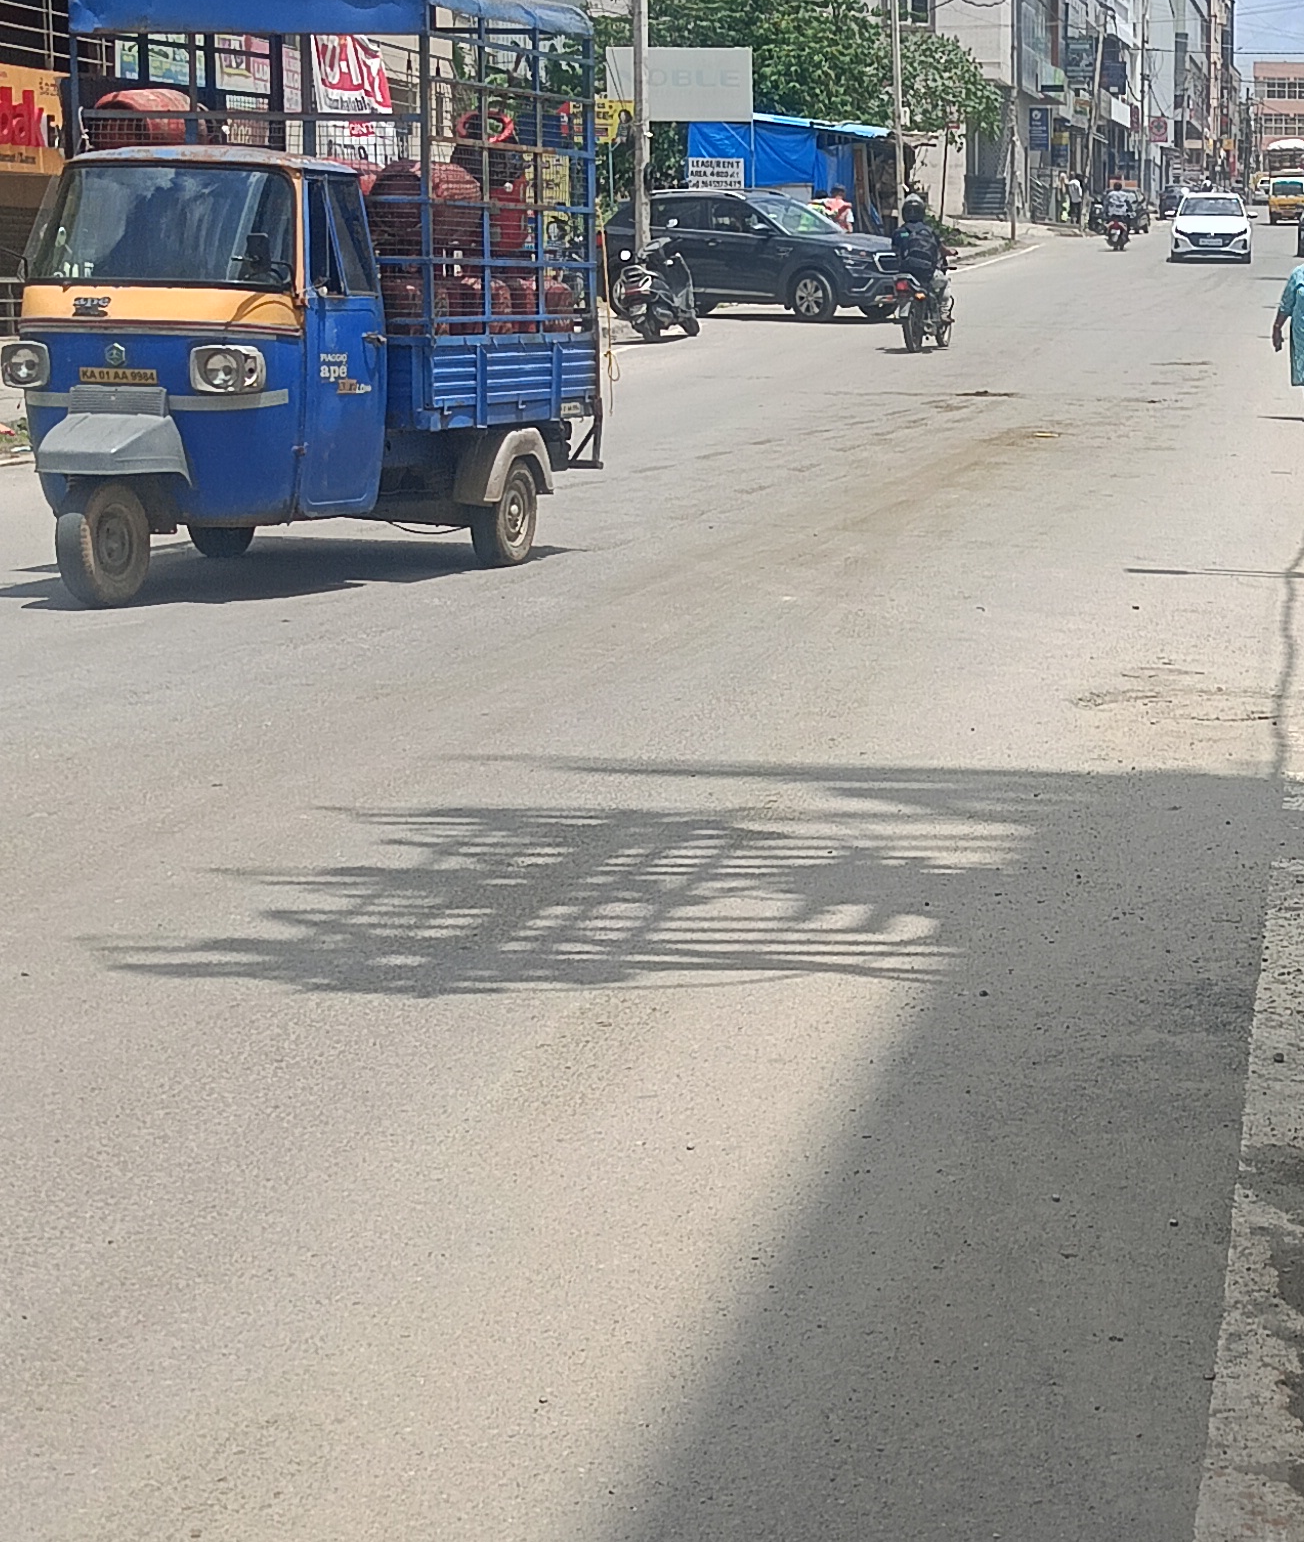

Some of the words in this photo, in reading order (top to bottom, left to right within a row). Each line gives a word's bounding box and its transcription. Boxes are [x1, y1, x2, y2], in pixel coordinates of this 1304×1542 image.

[81, 369, 98, 380] KA
[98, 370, 111, 381] 01
[113, 371, 129, 382] AA
